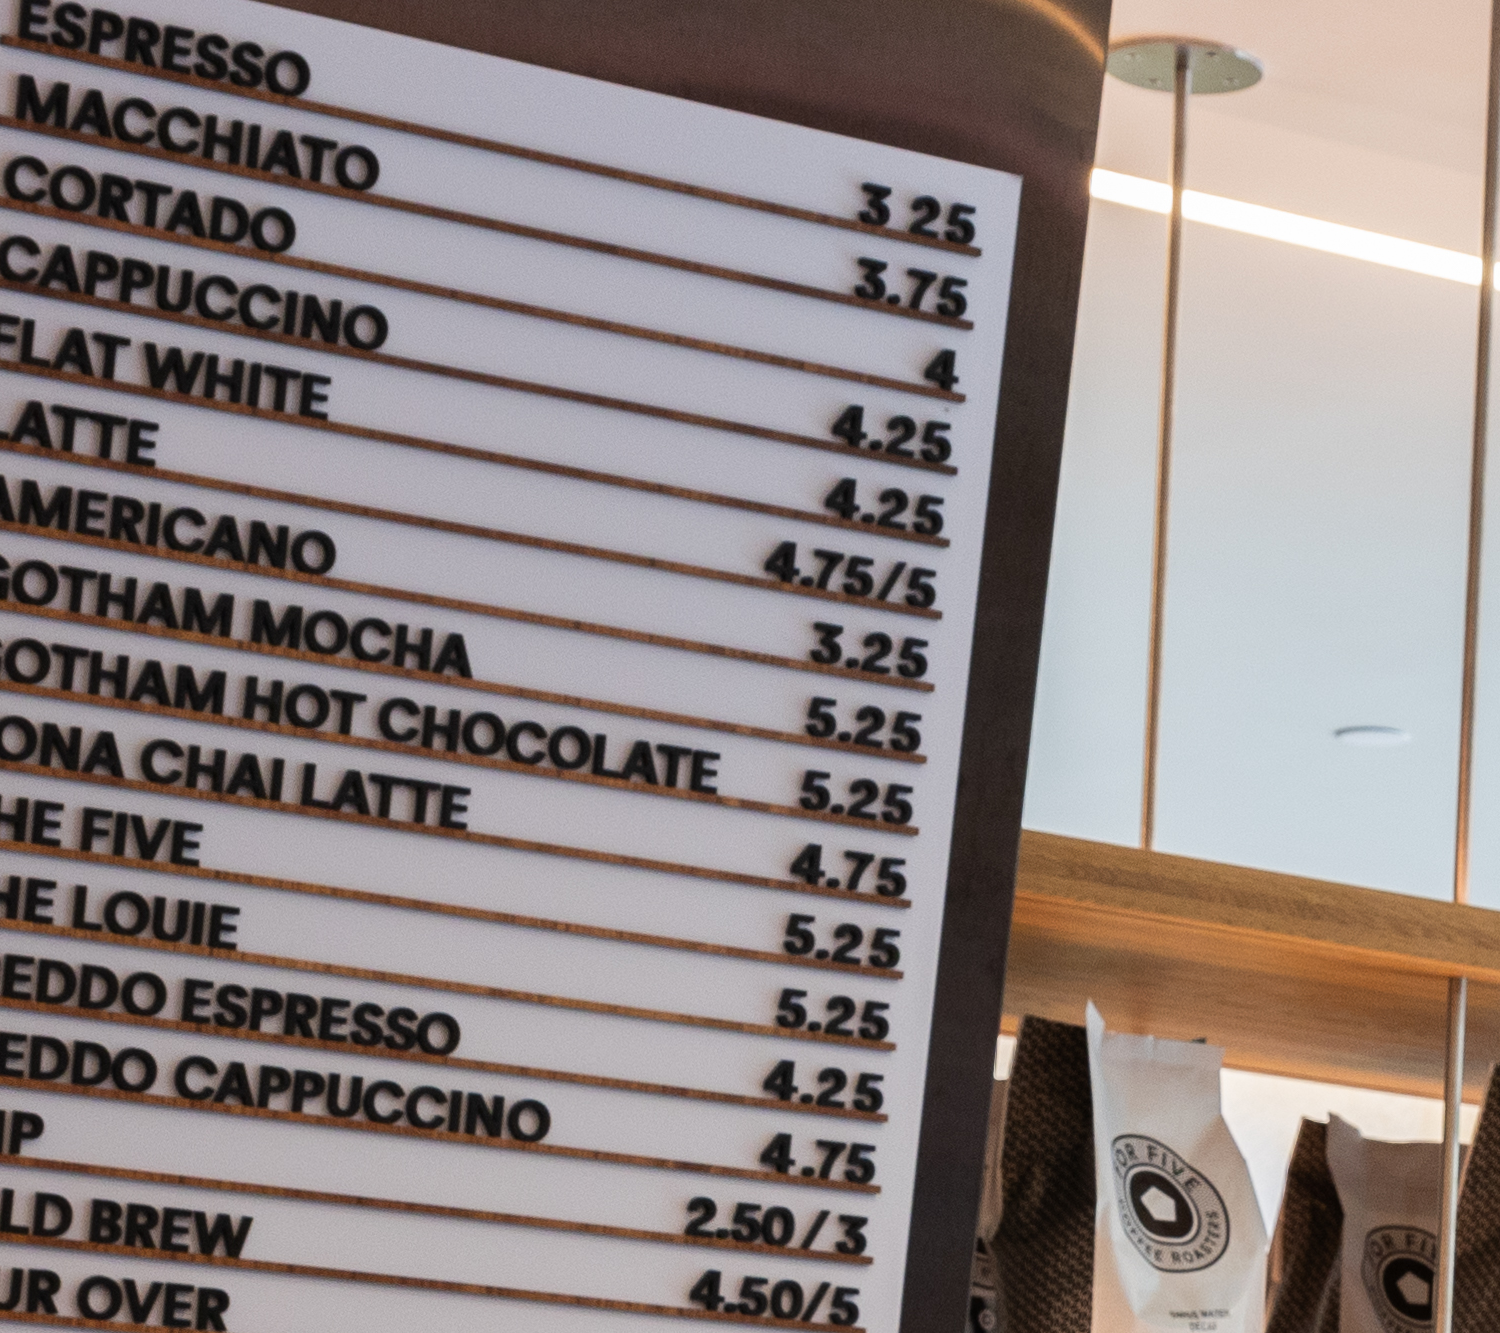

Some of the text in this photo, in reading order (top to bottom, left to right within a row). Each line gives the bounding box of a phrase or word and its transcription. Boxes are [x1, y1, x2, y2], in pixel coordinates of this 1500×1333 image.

[15, 0, 312, 100] ESPRESSO
[11, 73, 969, 322] MACCHIATO 3.75
[1, 154, 960, 394] CORTADO 4
[142, 341, 333, 423] WHITE
[823, 477, 945, 539] 4.25
[830, 404, 953, 468] 4.25
[762, 540, 938, 611] 4.75/5
[248, 598, 474, 681] MOCHA
[804, 695, 923, 755] 5.25
[808, 620, 929, 681] 3.25
[138, 737, 286, 804] CHAI
[298, 761, 473, 832] LATTE
[788, 843, 908, 900] 4.75
[240, 674, 369, 737] HOT
[376, 696, 722, 797] CHOCOLATE
[797, 769, 915, 828] 5.25
[78, 806, 205, 869] FIVE
[782, 912, 902, 971] 5.25
[70, 883, 242, 953] LOUIE
[774, 987, 891, 1043] 5.25
[179, 977, 462, 1058] ESPRESSO
[761, 1059, 885, 1115] 4.25
[172, 1054, 552, 1145] CAPPUCCINO
[758, 1132, 877, 1187] 4.75
[75, 1274, 231, 1333] OVER
[87, 1197, 254, 1261] BREW
[688, 1269, 861, 1329] 4.50/5
